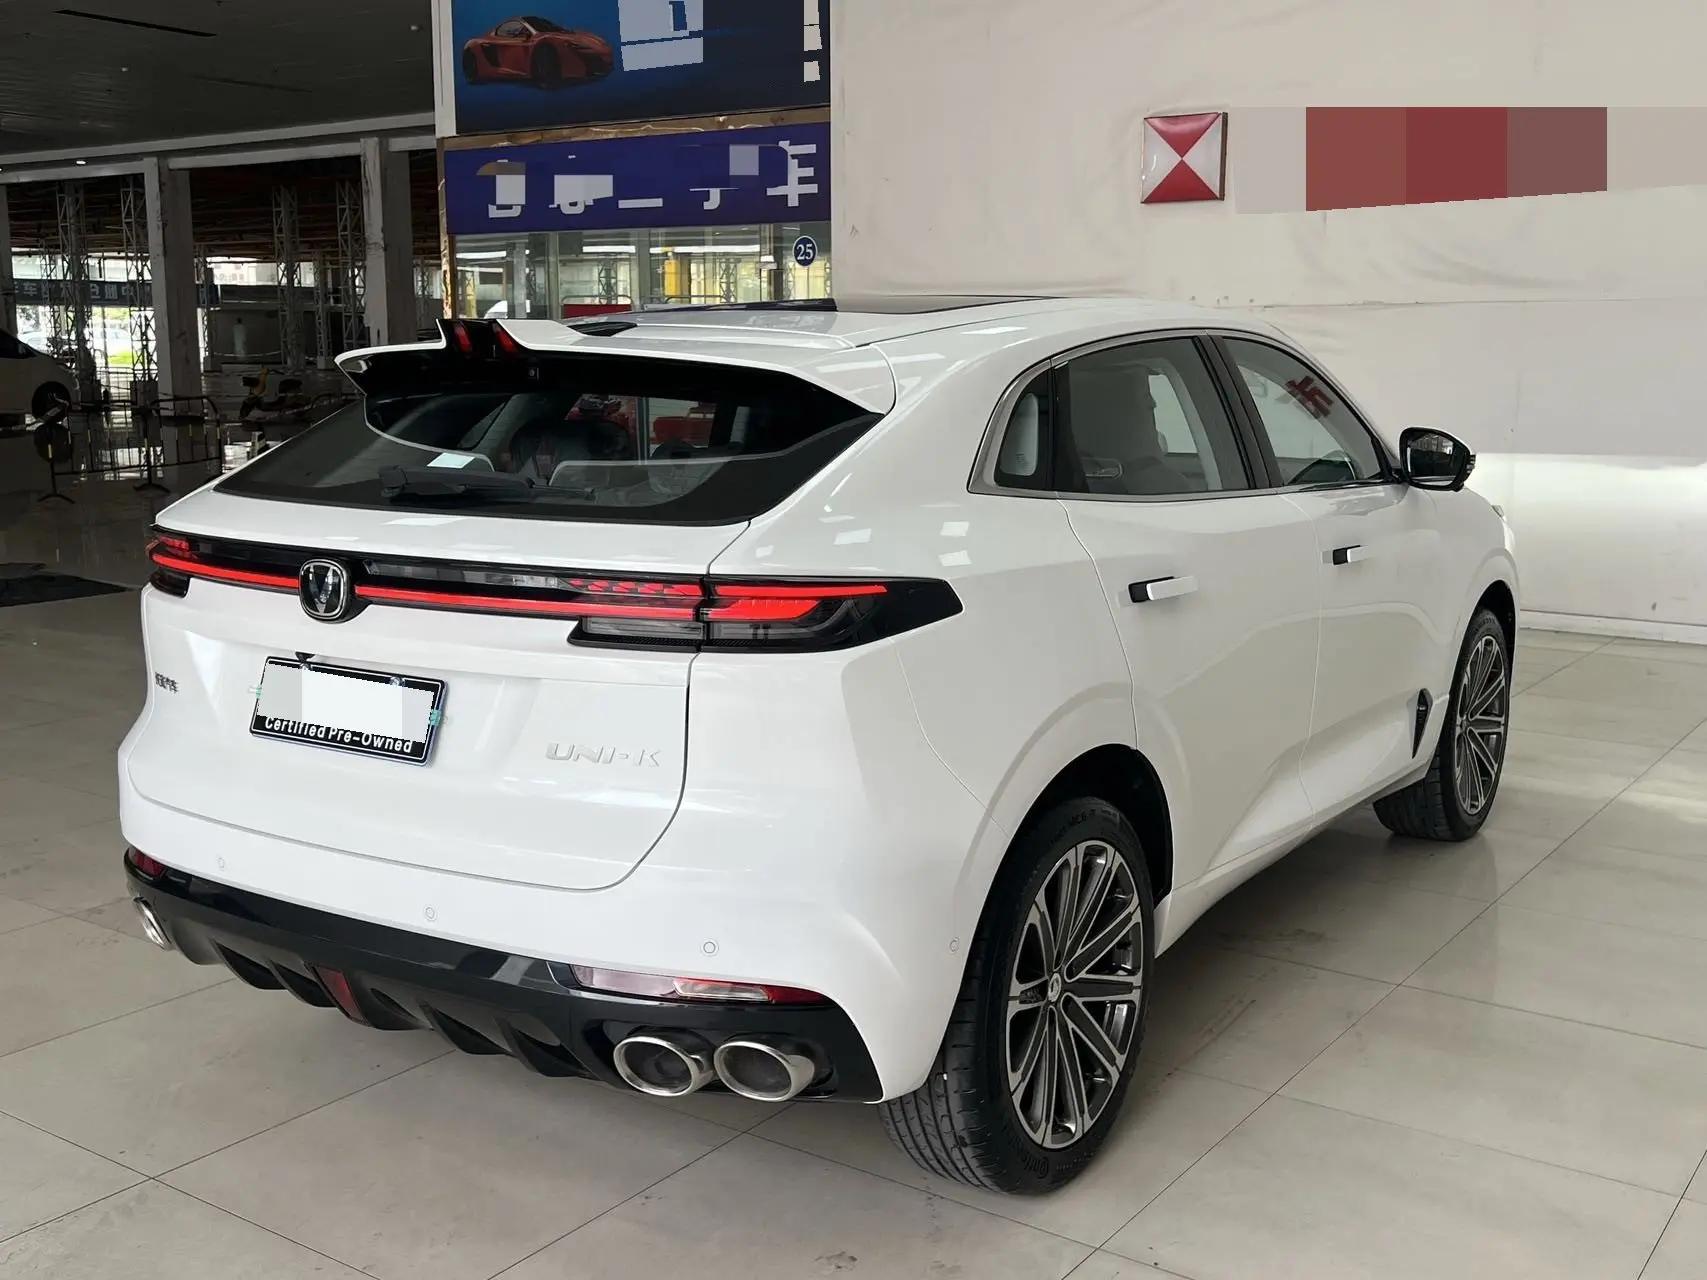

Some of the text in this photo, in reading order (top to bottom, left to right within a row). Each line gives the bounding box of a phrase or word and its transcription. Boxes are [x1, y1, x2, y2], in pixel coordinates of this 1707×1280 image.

[796, 243, 814, 260] 25
[265, 716, 412, 753] Certified Pre-Owned
[546, 742, 661, 767] UNI-K
